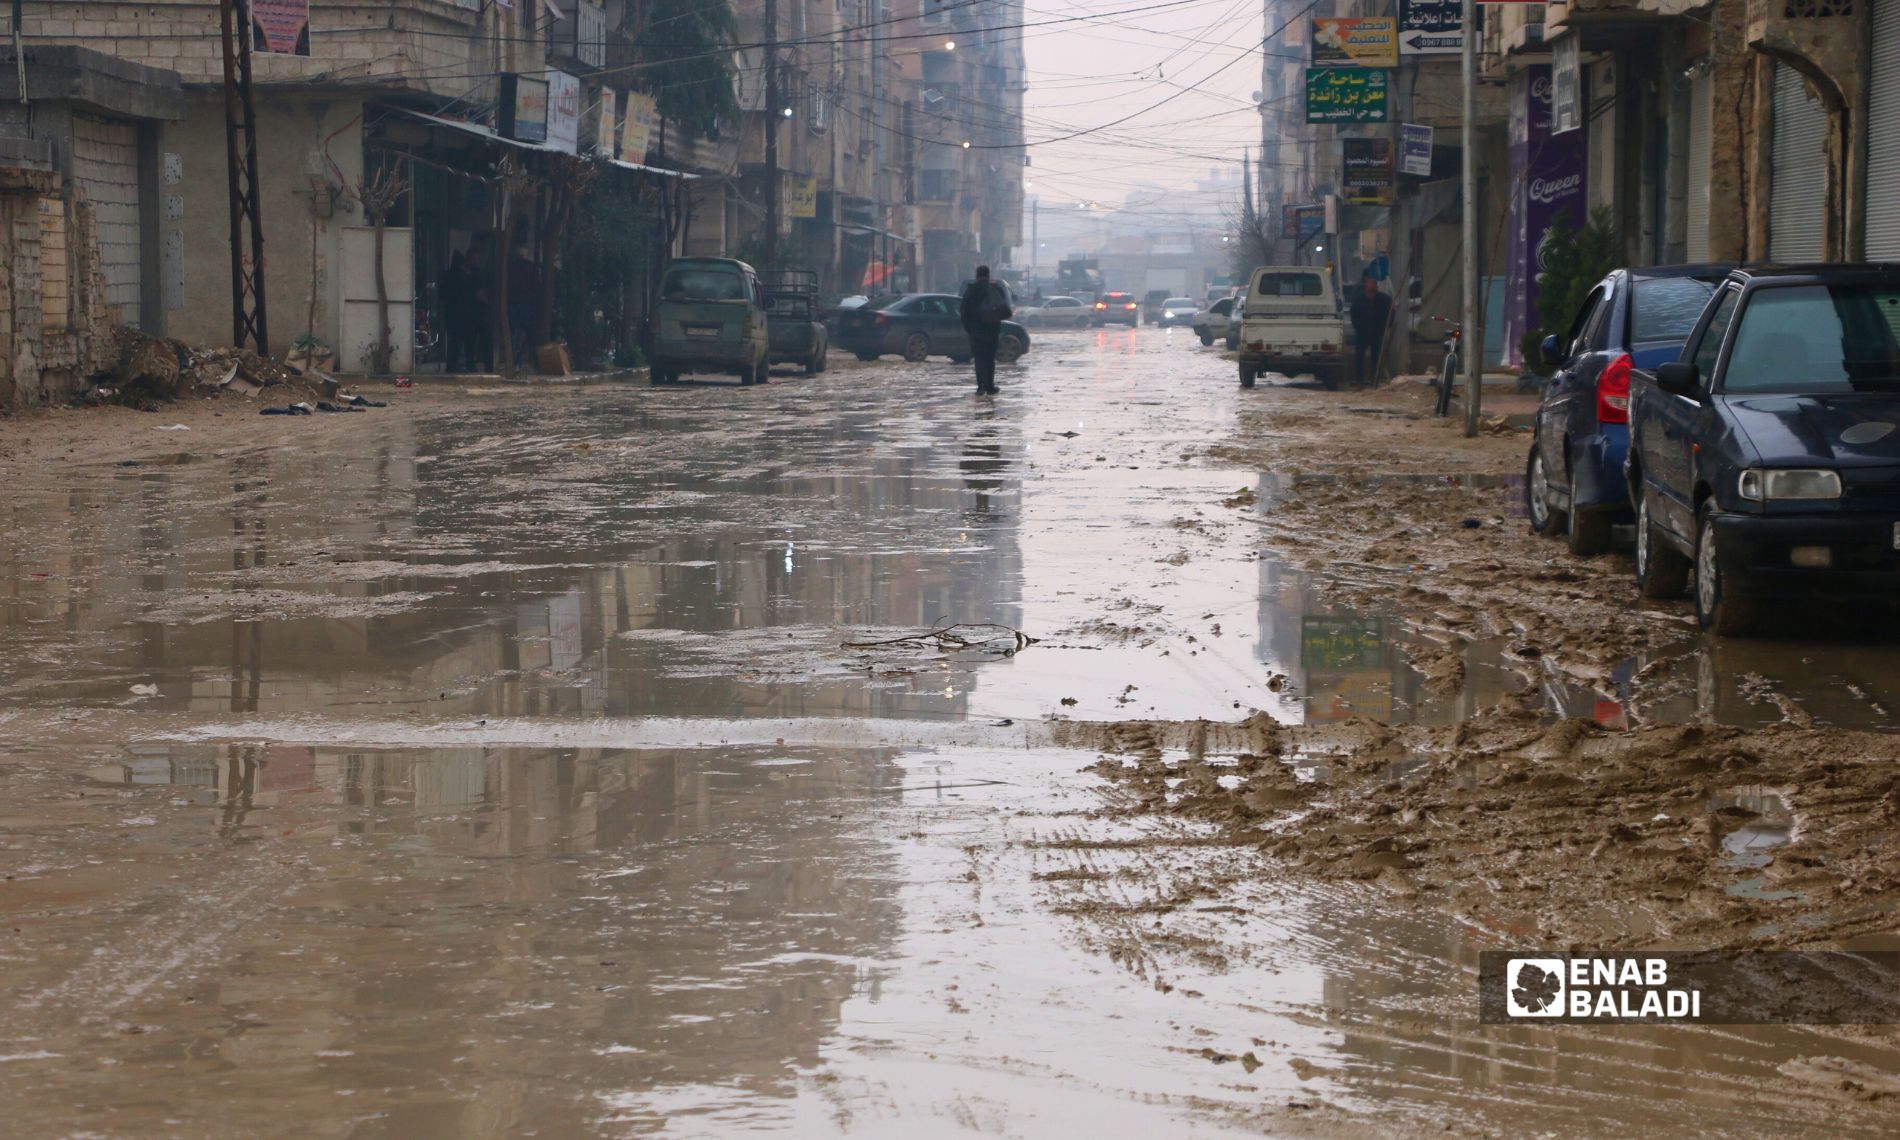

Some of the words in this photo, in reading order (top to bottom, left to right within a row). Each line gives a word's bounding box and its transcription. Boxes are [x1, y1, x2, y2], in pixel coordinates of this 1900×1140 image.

[1328, 71, 1365, 85] ساحة
[1309, 87, 1341, 104] زائدة
[1343, 88, 1360, 104] بن
[1362, 88, 1385, 104] معن
[1325, 107, 1355, 119] الخطيب
[1529, 173, 1582, 204] Queen
